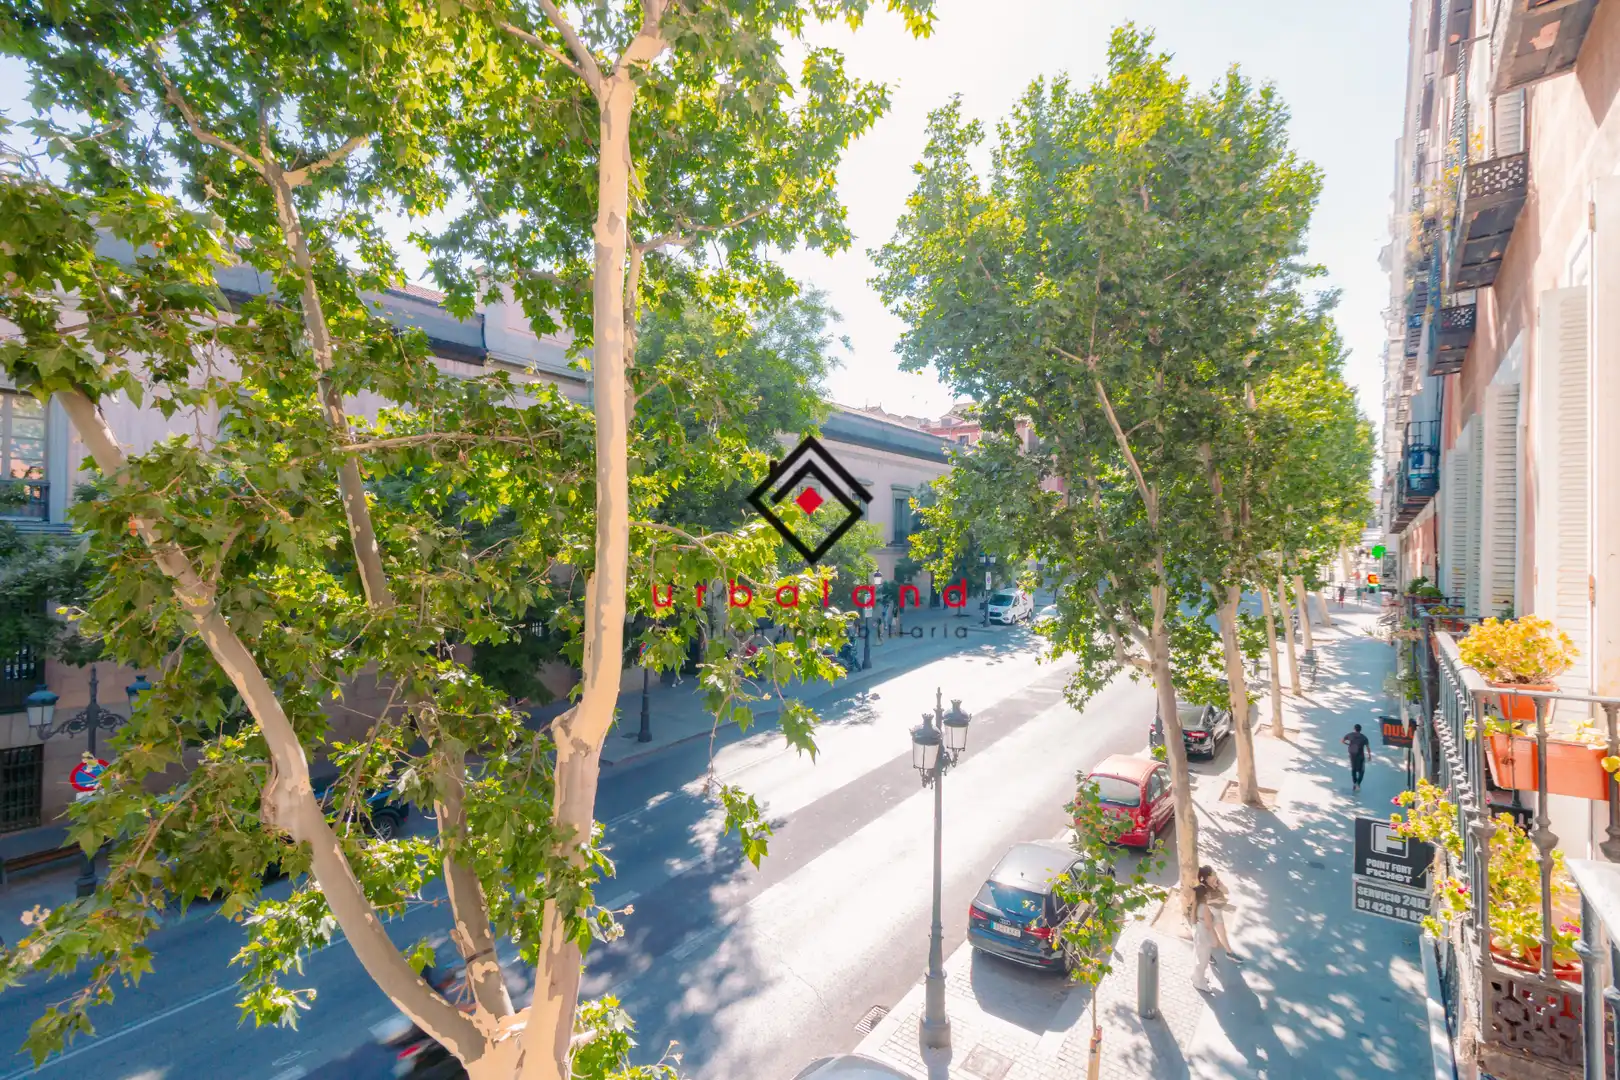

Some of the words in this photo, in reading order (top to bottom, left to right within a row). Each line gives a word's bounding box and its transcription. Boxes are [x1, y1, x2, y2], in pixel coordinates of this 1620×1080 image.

[1366, 858, 1391, 870] POINT
[1391, 863, 1413, 875] FORT
[1357, 886, 1401, 904] SERVICIO
